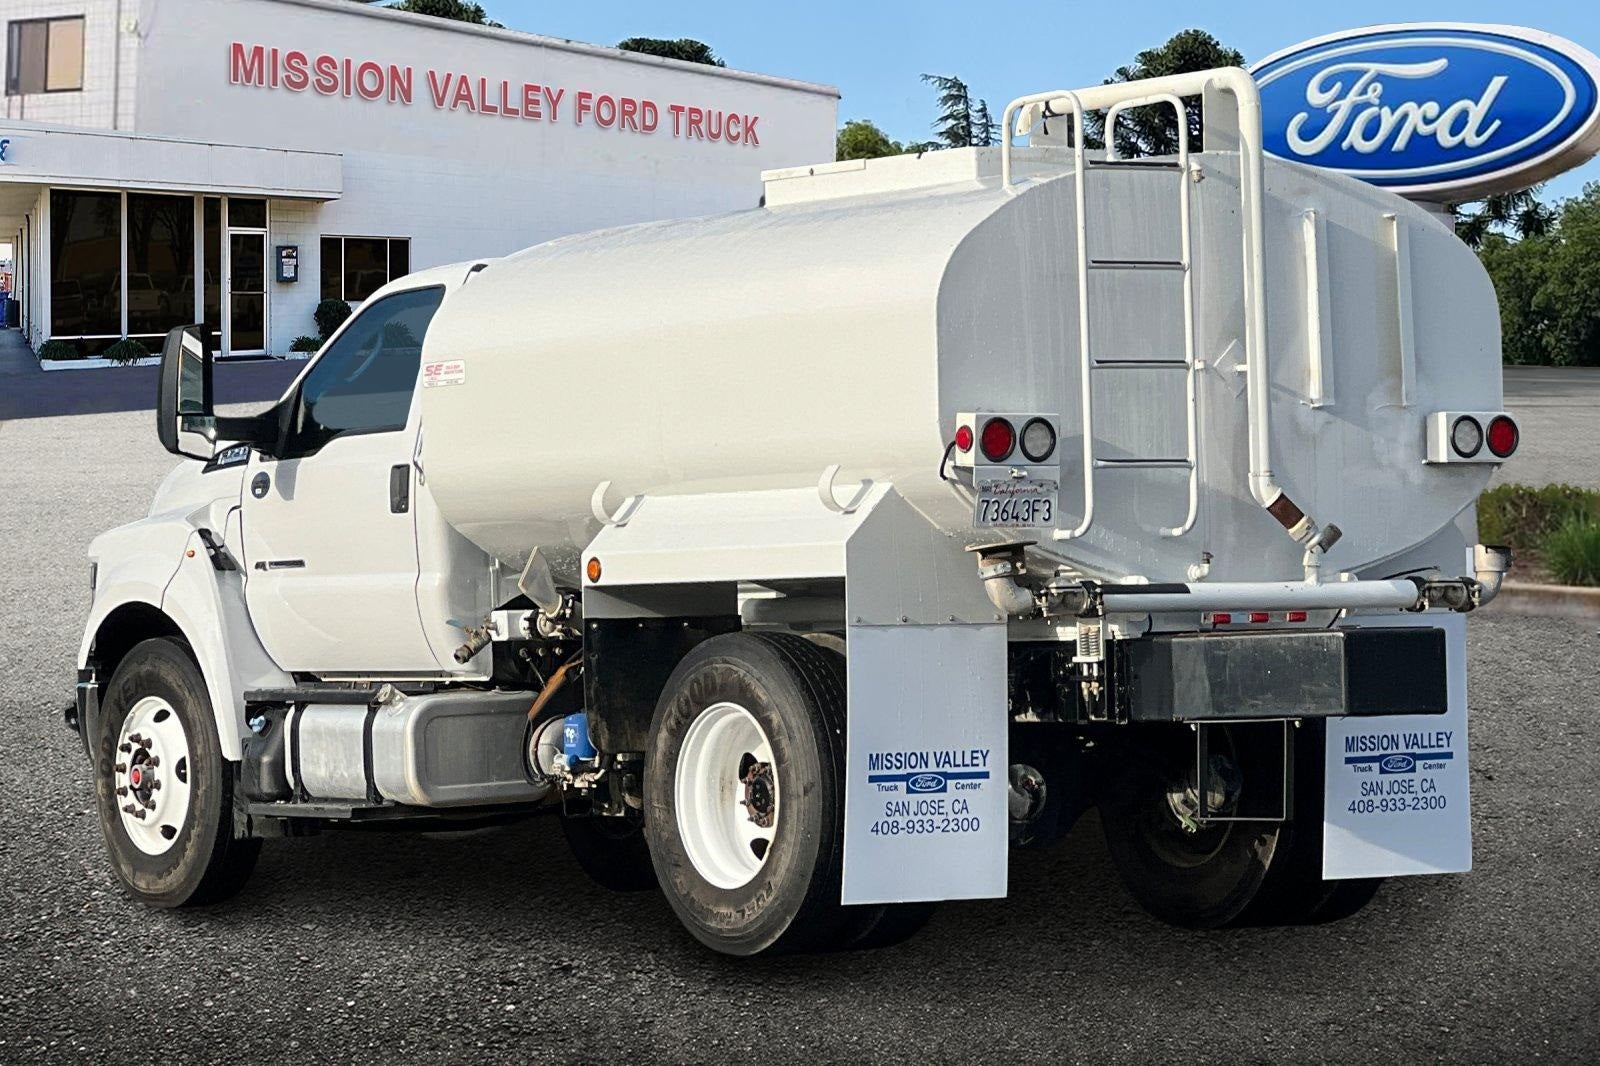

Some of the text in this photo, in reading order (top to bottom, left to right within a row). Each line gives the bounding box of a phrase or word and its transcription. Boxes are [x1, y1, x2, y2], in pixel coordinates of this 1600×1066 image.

[230, 42, 760, 145] MISSION VALLEY FORD TRUCK
[1286, 58, 1508, 156] Ford
[993, 483, 1041, 498] California
[981, 499, 1051, 522] 73643F3
[1345, 731, 1453, 753] MISSION VALLEY
[868, 749, 990, 771] MISSION VALLEY
[1353, 757, 1447, 773] Truck Ford Center
[877, 775, 982, 792] Truck Ford Center
[1361, 778, 1437, 797] SAN JOSE, CA
[885, 798, 969, 817] SAN JOSE, CA
[1348, 795, 1447, 814] 408-933-2300
[870, 817, 980, 835] 408-933-2300
